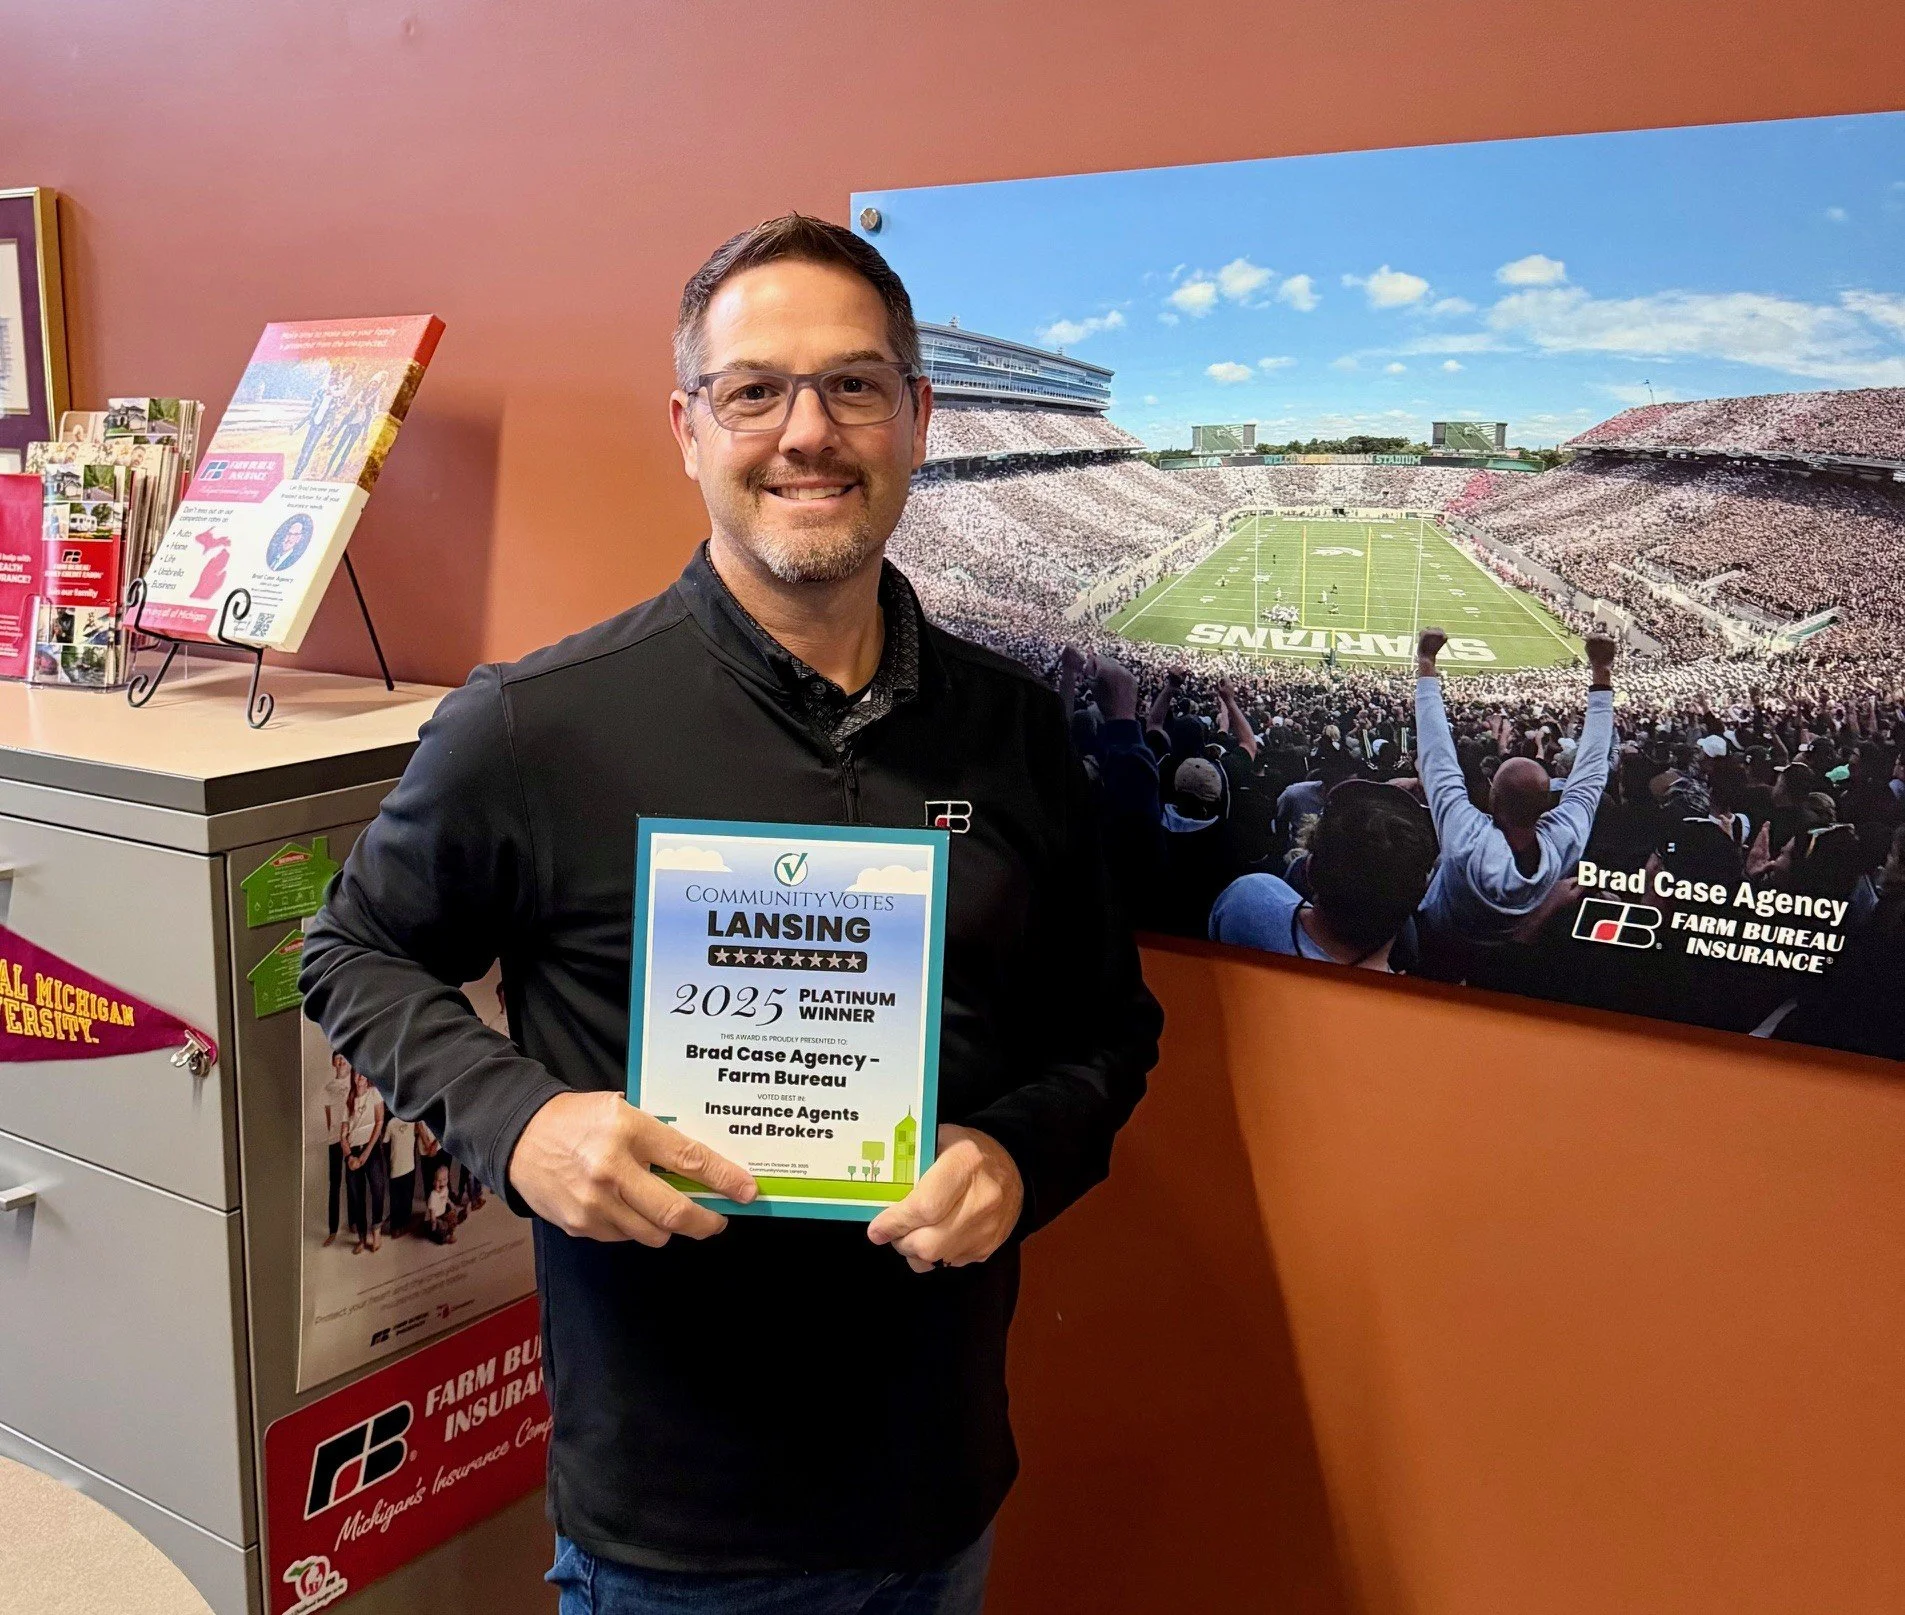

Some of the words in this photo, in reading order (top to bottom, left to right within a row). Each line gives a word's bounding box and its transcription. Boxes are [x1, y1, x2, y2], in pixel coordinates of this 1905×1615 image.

[1375, 454, 1422, 466] STADIUM
[176, 530, 192, 538] Auto
[170, 541, 188, 550] Home
[3, 551, 17, 563] help
[17, 554, 32, 563] with
[164, 554, 176, 563] Life
[157, 567, 185, 577] Umbrella
[150, 579, 178, 590] Business
[74, 588, 99, 600] family
[180, 609, 209, 623] Michigan
[1186, 622, 1498, 662] SARTANS
[1577, 859, 1646, 894] Brad
[1653, 870, 1728, 905] Case
[1732, 881, 1850, 927] Agency
[706, 910, 872, 944] LANSING
[1670, 911, 1738, 938] FARM
[1742, 922, 1846, 953] BUREAU
[35, 972, 135, 1027] MICHIGAN
[669, 983, 788, 1027] 2025
[799, 988, 897, 1008] PLATINUM
[799, 1006, 876, 1024] WINNER
[720, 1032, 734, 1041] THIS
[735, 1033, 761, 1042] AWARD
[761, 1034, 768, 1042] IS
[769, 1035, 799, 1044] PROUDLY
[800, 1037, 835, 1046] PRESENTED
[836, 1038, 848, 1046] TO:
[685, 1043, 733, 1061] Brad
[736, 1046, 787, 1064] Case
[789, 1049, 867, 1072] Agency
[717, 1067, 771, 1085] Farm
[773, 1070, 847, 1088] Bureau
[757, 1093, 779, 1102] VOTED
[780, 1093, 797, 1102] BEST
[704, 1101, 794, 1119] Insurance
[796, 1106, 860, 1124] Agents
[728, 1122, 761, 1137] and
[765, 1123, 834, 1140] Brokers
[425, 1356, 497, 1418] FARM
[333, 1476, 427, 1553] Michigan's
[431, 1440, 511, 1496] Insurance
